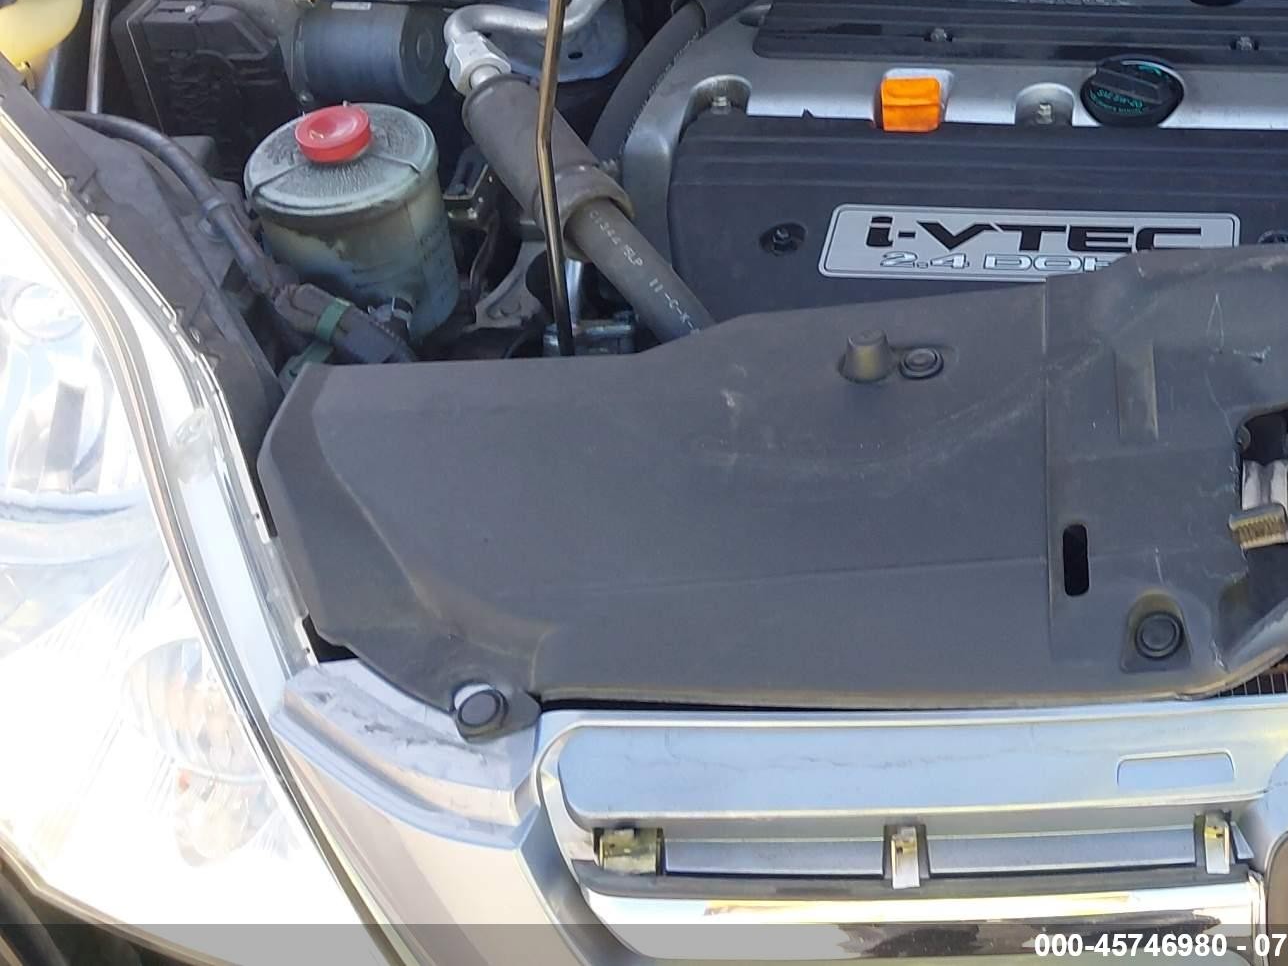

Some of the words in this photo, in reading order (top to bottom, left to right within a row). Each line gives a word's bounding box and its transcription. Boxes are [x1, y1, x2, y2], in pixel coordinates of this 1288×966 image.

[865, 215, 1202, 253] i-VTEC
[879, 250, 970, 269] 2.4
[983, 252, 1117, 272] DOH
